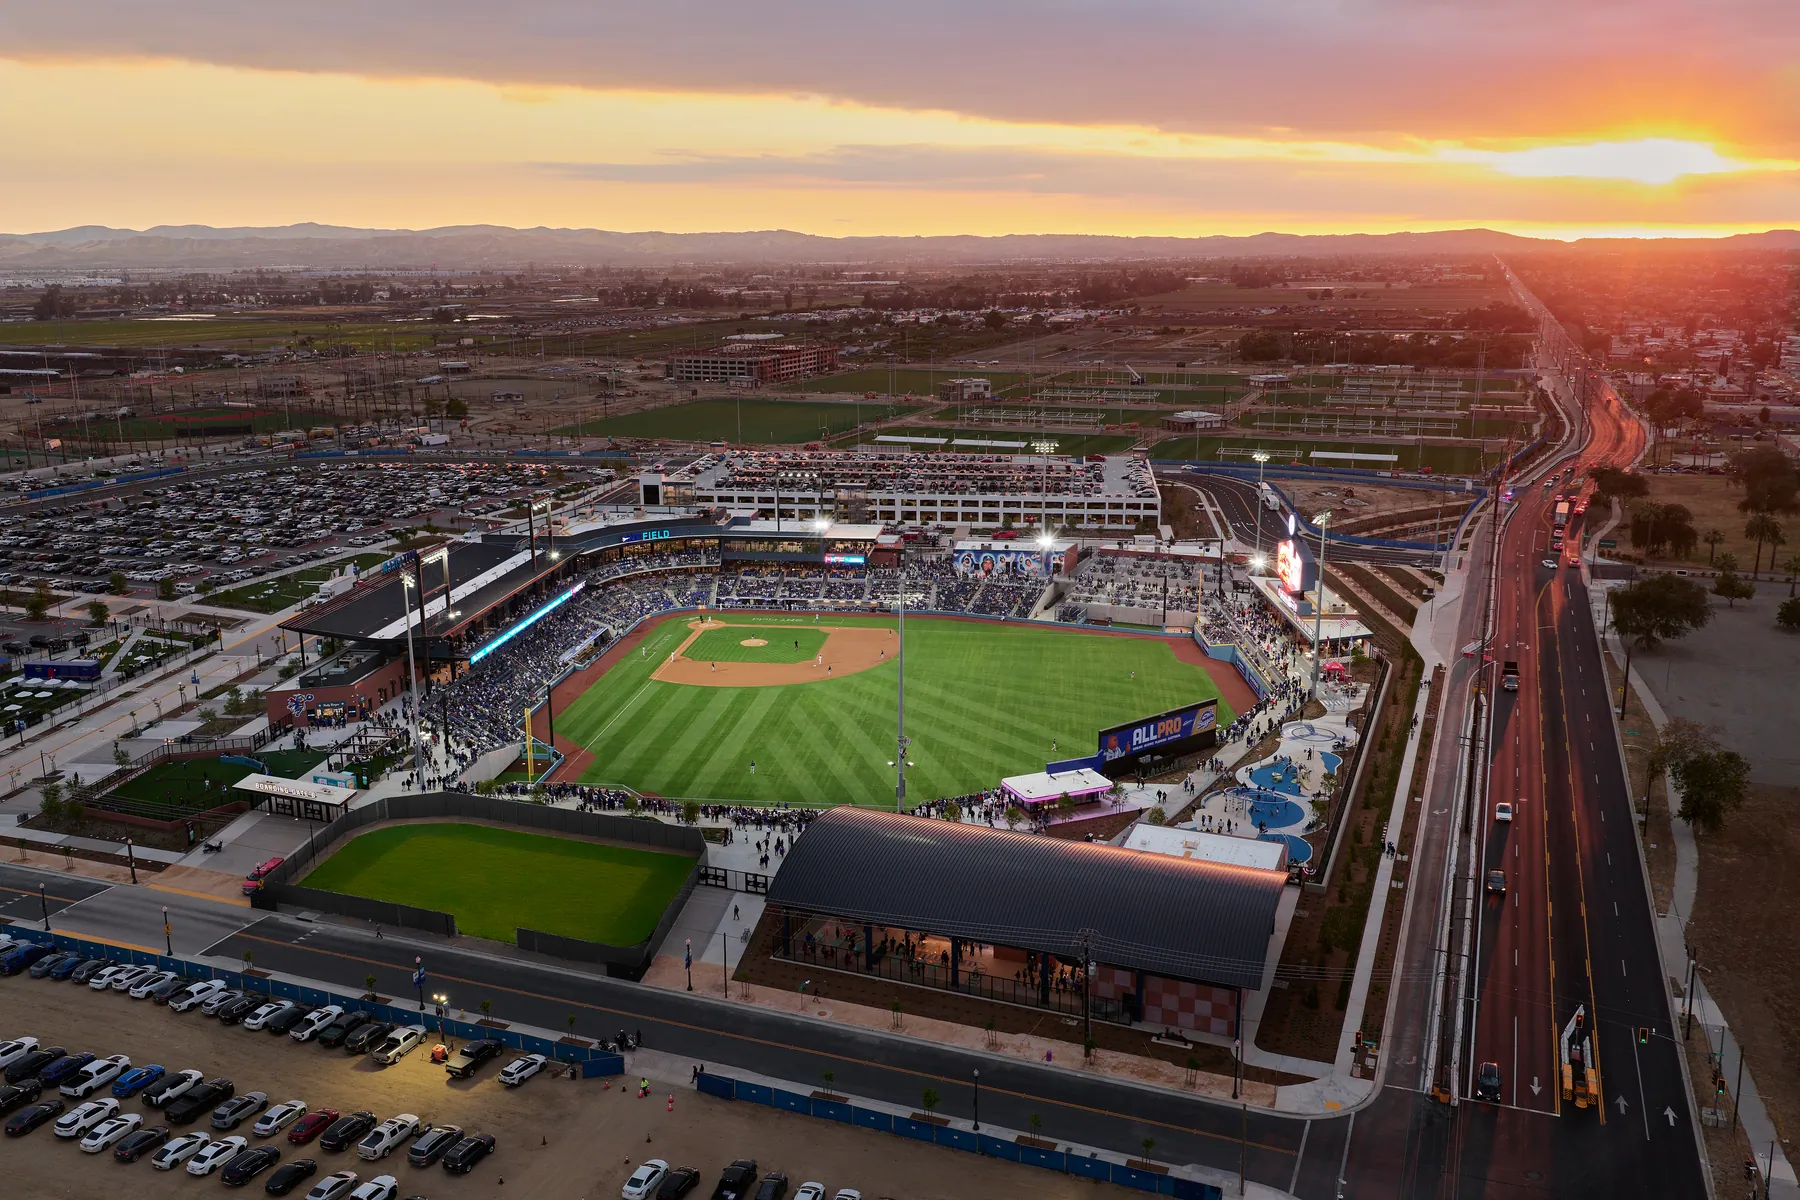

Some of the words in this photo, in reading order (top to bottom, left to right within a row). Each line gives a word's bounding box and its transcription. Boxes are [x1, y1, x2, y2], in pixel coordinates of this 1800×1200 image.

[642, 529, 670, 541] FIELD
[255, 782, 289, 794] BOARDING
[291, 788, 309, 798] GATE
